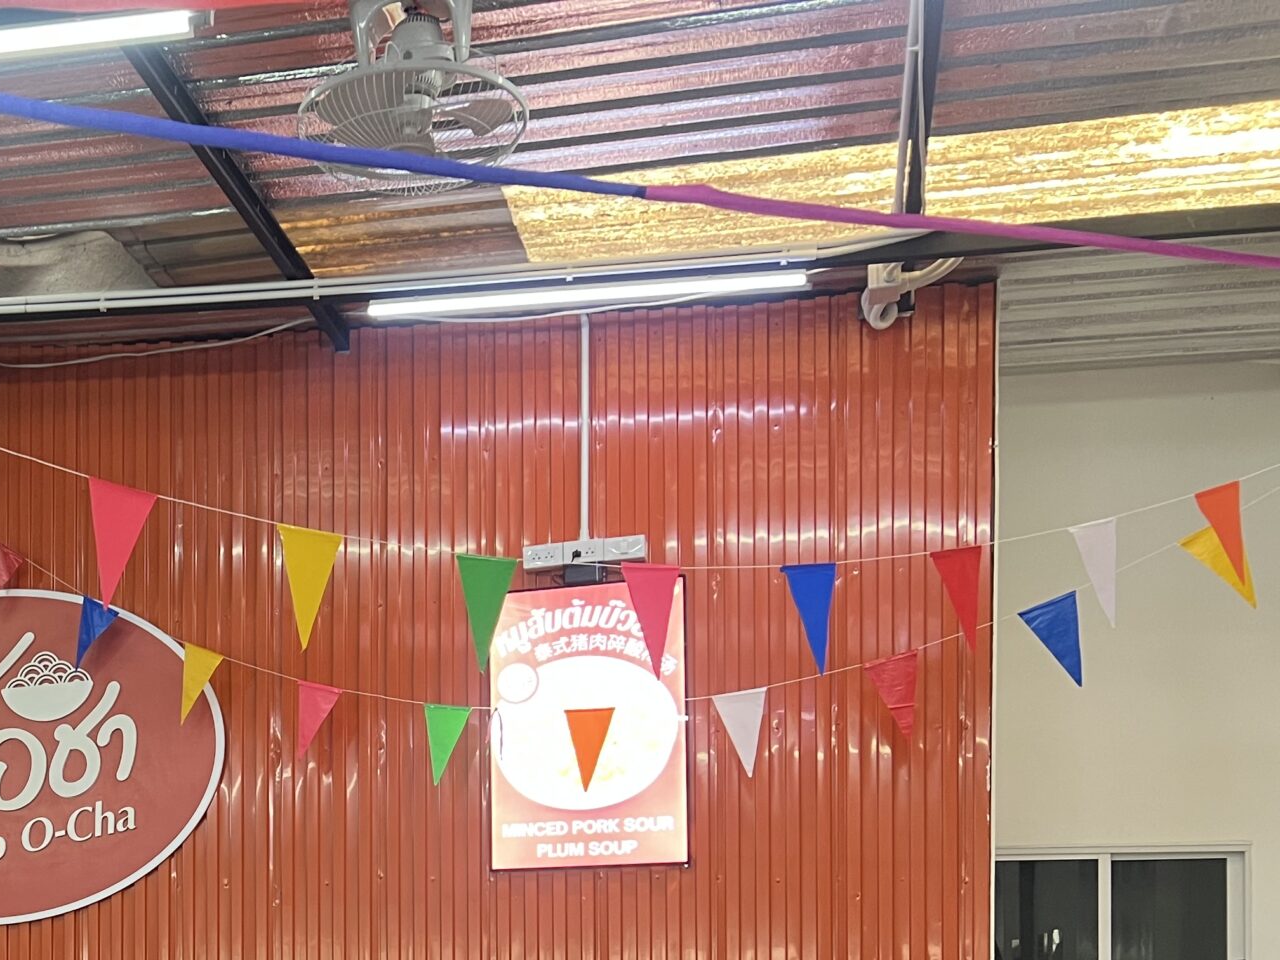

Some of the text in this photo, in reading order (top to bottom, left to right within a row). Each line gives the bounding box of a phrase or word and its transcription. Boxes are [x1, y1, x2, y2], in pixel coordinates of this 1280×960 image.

[20, 800, 136, 853] O-Cha
[501, 815, 674, 838] MINCED PORK SOUR
[536, 839, 638, 858] PLUM SOUP
